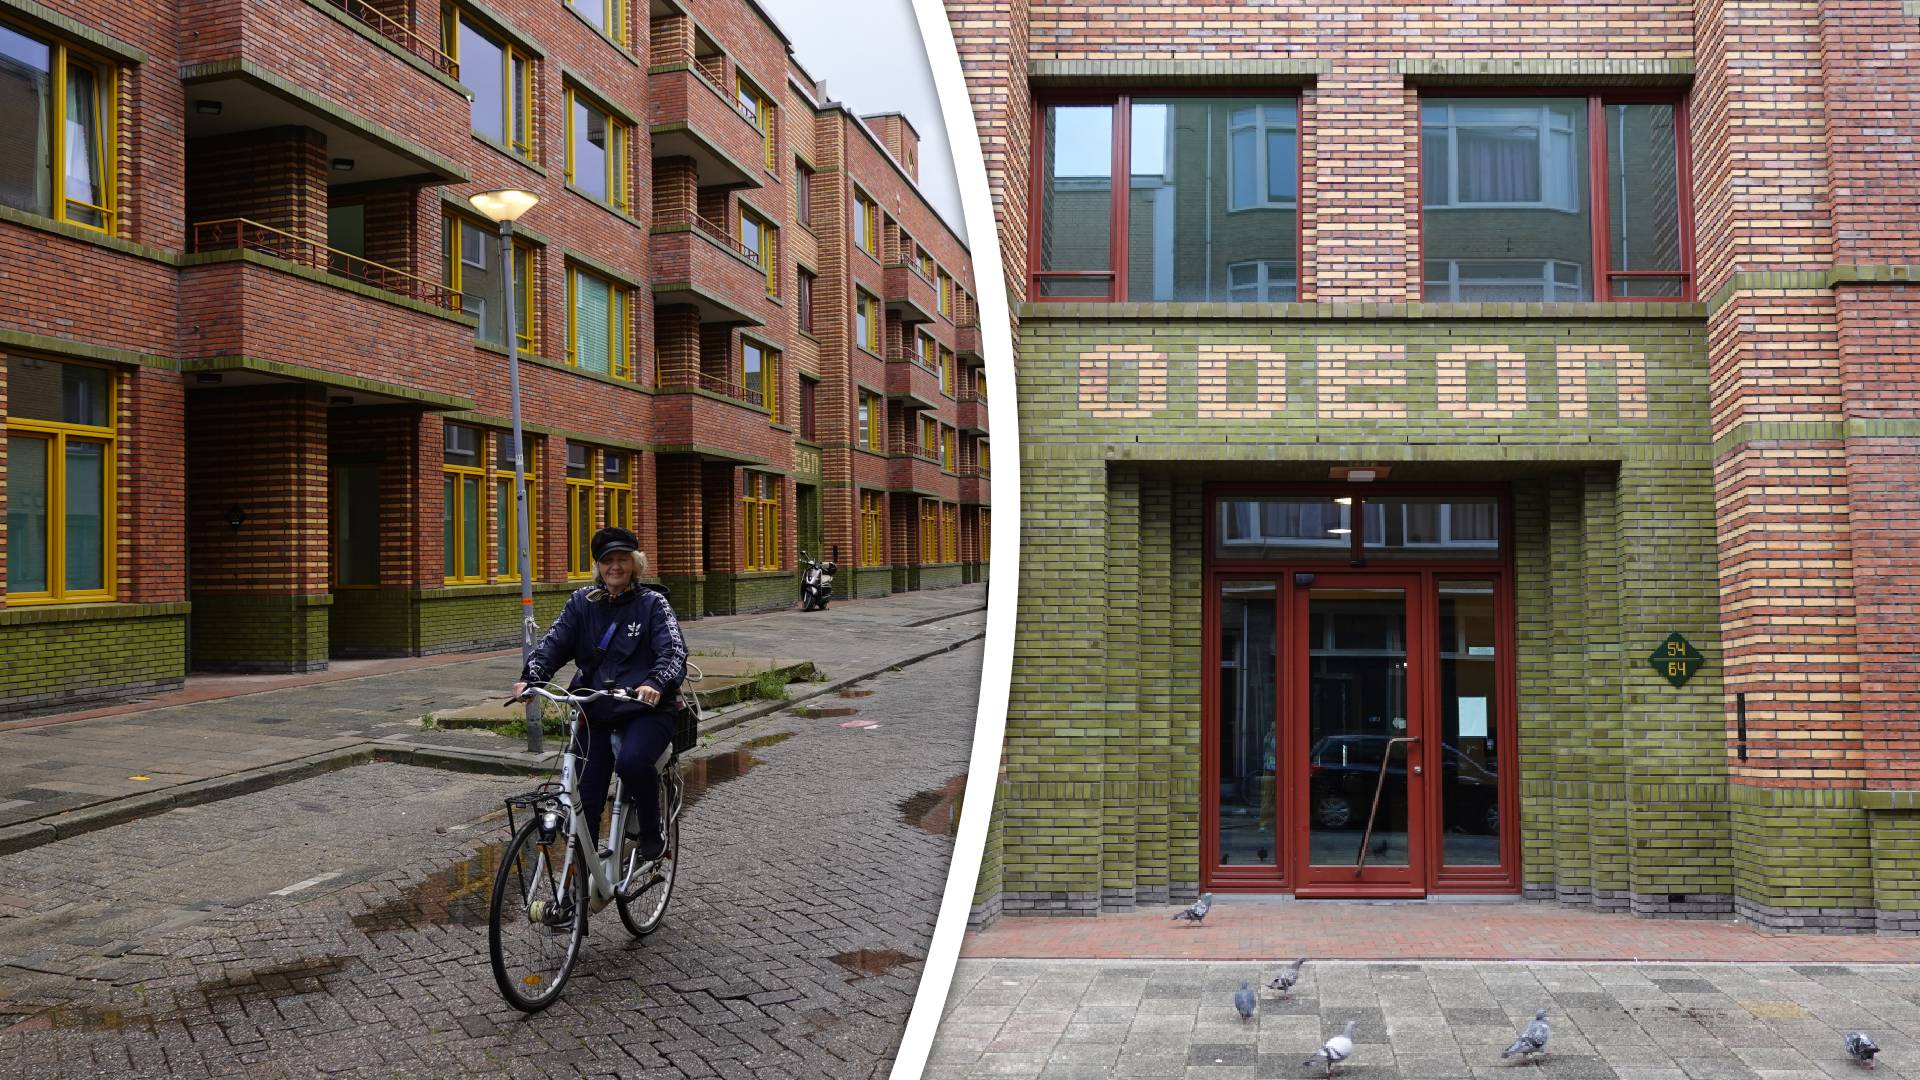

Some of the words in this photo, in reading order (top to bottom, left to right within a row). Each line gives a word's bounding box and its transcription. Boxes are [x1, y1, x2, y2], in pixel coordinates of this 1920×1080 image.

[1078, 344, 1648, 418] ODEON
[1667, 641, 1686, 656] 54
[1668, 661, 1686, 676] 64
